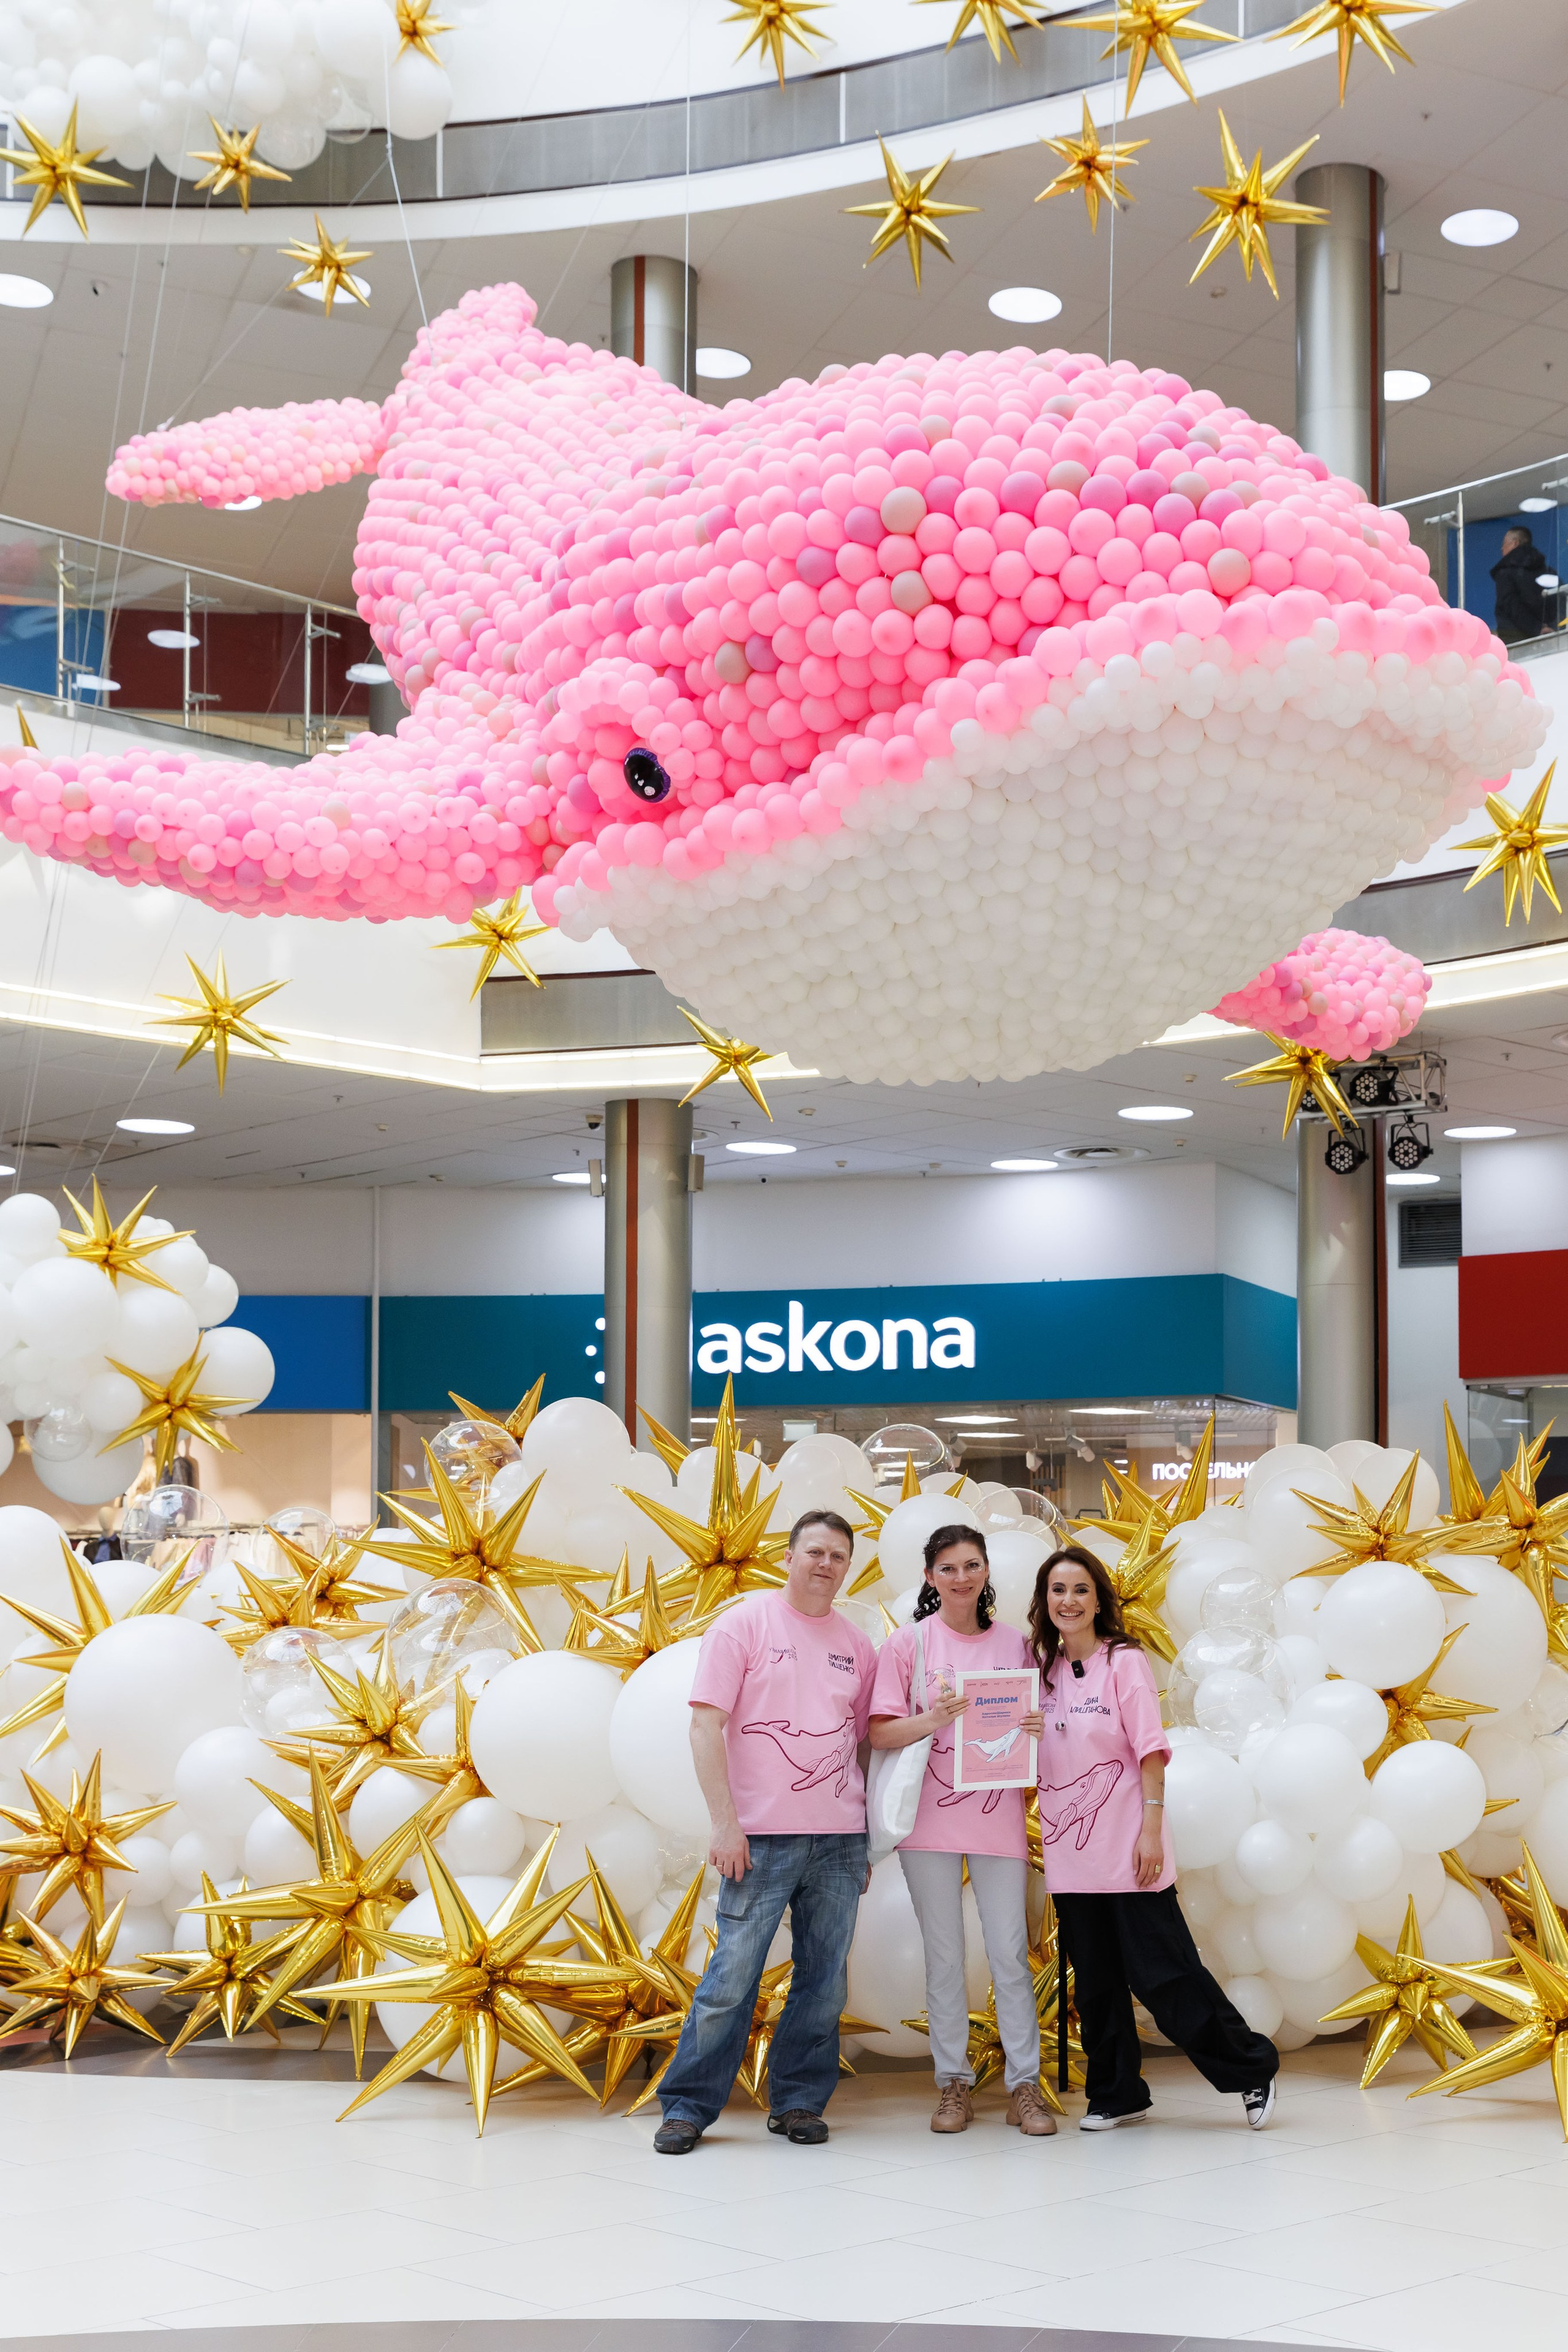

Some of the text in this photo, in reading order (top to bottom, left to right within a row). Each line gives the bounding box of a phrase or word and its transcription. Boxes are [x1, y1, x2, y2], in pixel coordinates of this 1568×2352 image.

[697, 1300, 976, 1374] askona
[828, 1653, 854, 1665] ДМИТРИЙ
[975, 1696, 1018, 1706] Диплом
[1084, 1696, 1099, 1706] ДИНА
[1069, 1705, 1111, 1716] АЛИШПАНОВА
